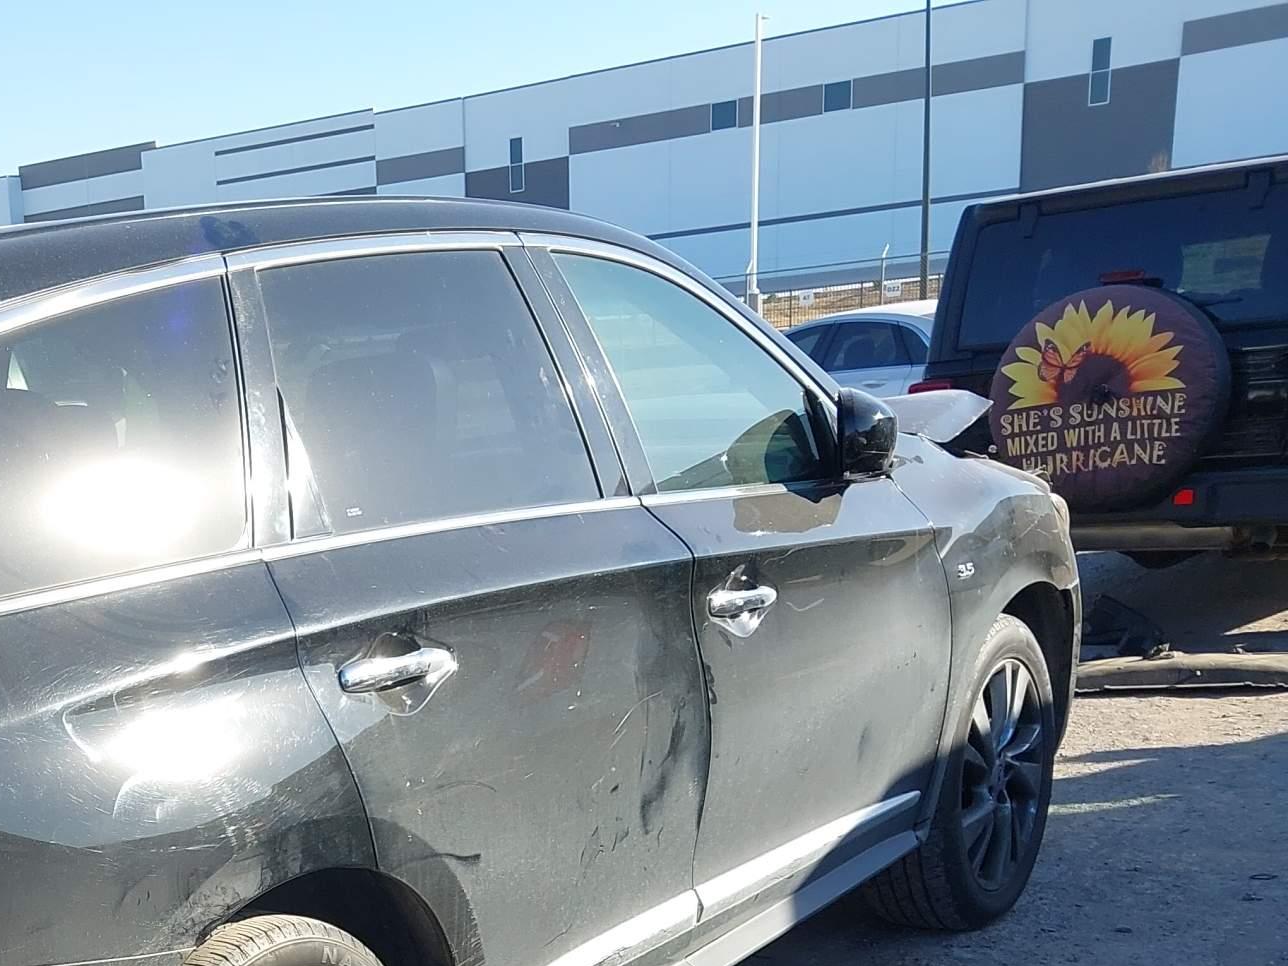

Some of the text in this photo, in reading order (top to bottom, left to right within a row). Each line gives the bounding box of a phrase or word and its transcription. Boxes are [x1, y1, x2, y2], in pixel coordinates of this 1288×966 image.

[1000, 392, 1187, 436] SHE'S SUNSHINE
[1006, 418, 1181, 457] MIXED WITH A LITTLE
[1022, 441, 1168, 476] HURRICANE
